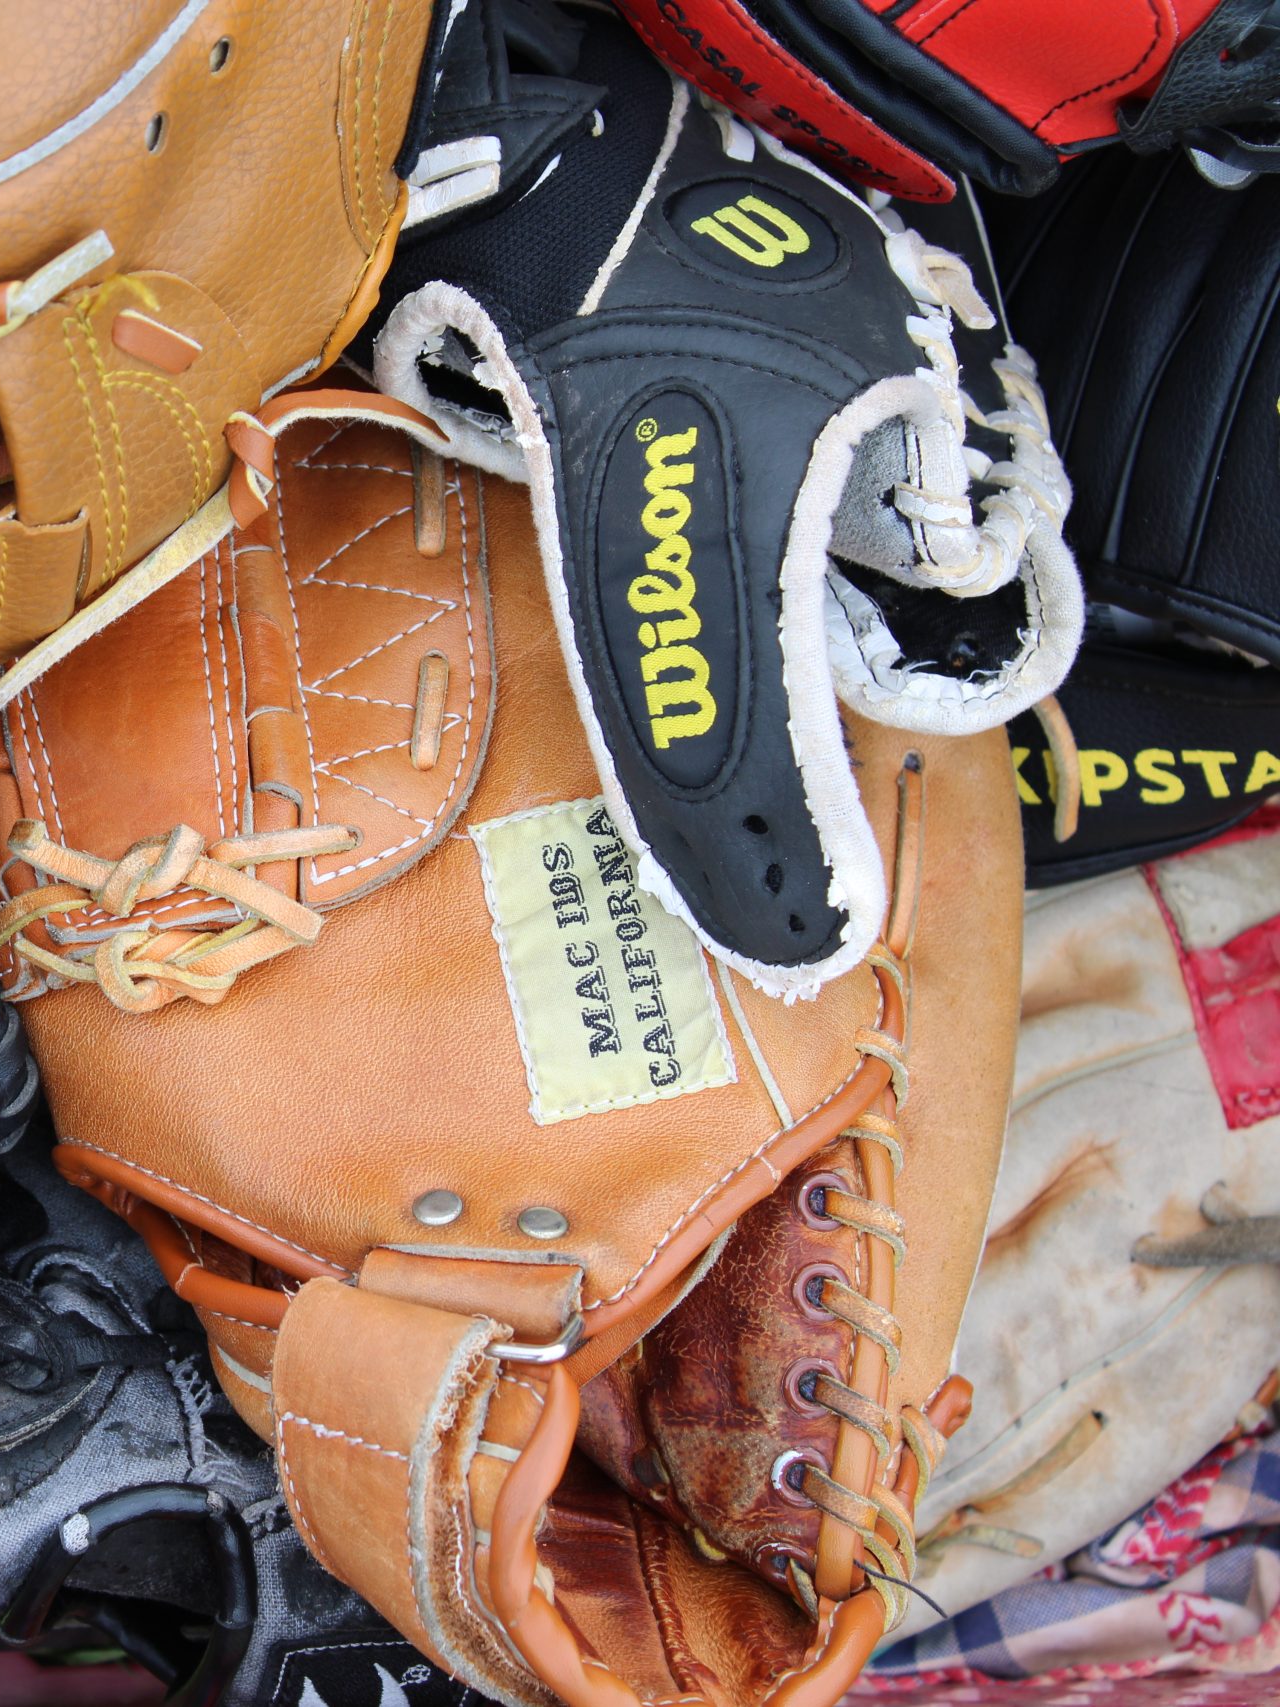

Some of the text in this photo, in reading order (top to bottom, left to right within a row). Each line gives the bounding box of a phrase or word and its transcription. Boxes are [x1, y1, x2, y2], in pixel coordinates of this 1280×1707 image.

[655, 0, 763, 97] CASAL
[690, 195, 810, 268] W
[564, 940, 620, 1058] MAC
[585, 806, 682, 1087] CALIFORNIA
